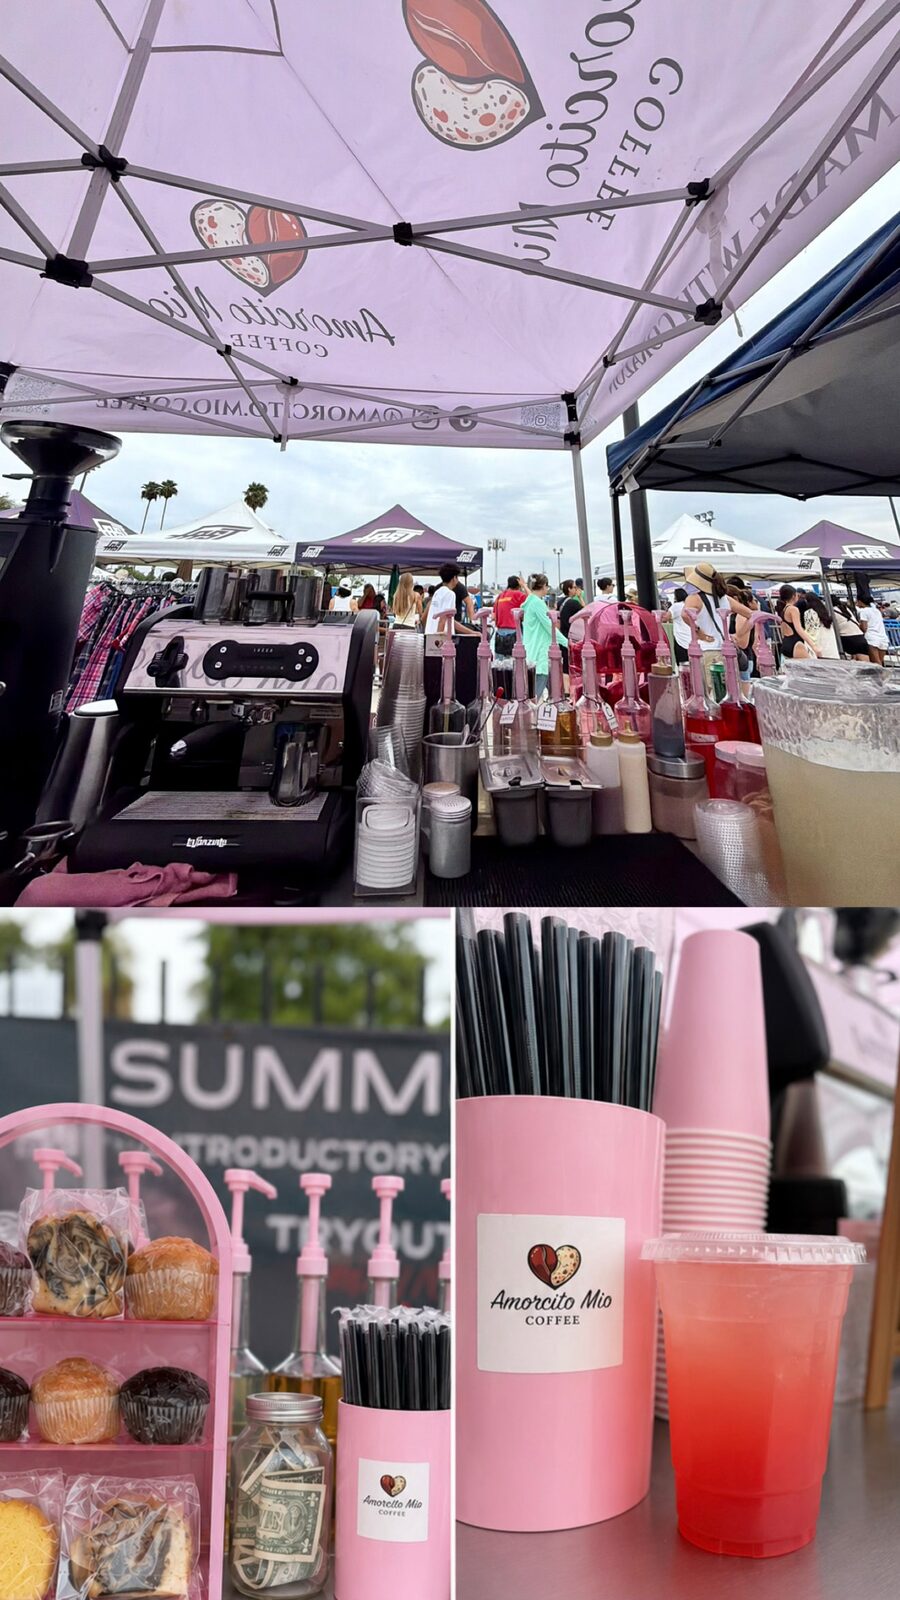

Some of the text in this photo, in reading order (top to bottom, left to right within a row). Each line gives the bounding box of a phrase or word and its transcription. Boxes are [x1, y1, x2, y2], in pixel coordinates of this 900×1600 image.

[683, 537, 736, 552] FAST
[659, 556, 677, 567] FAST
[542, 706, 552, 718] H
[110, 1039, 443, 1117] SUMM
[171, 1131, 450, 1175] TRODUCTORY
[490, 1289, 613, 1311] Amorcito Mio
[525, 1315, 580, 1326] COFFEE
[405, 1499, 423, 1509] Mio
[378, 1509, 406, 1517] COFFEE
